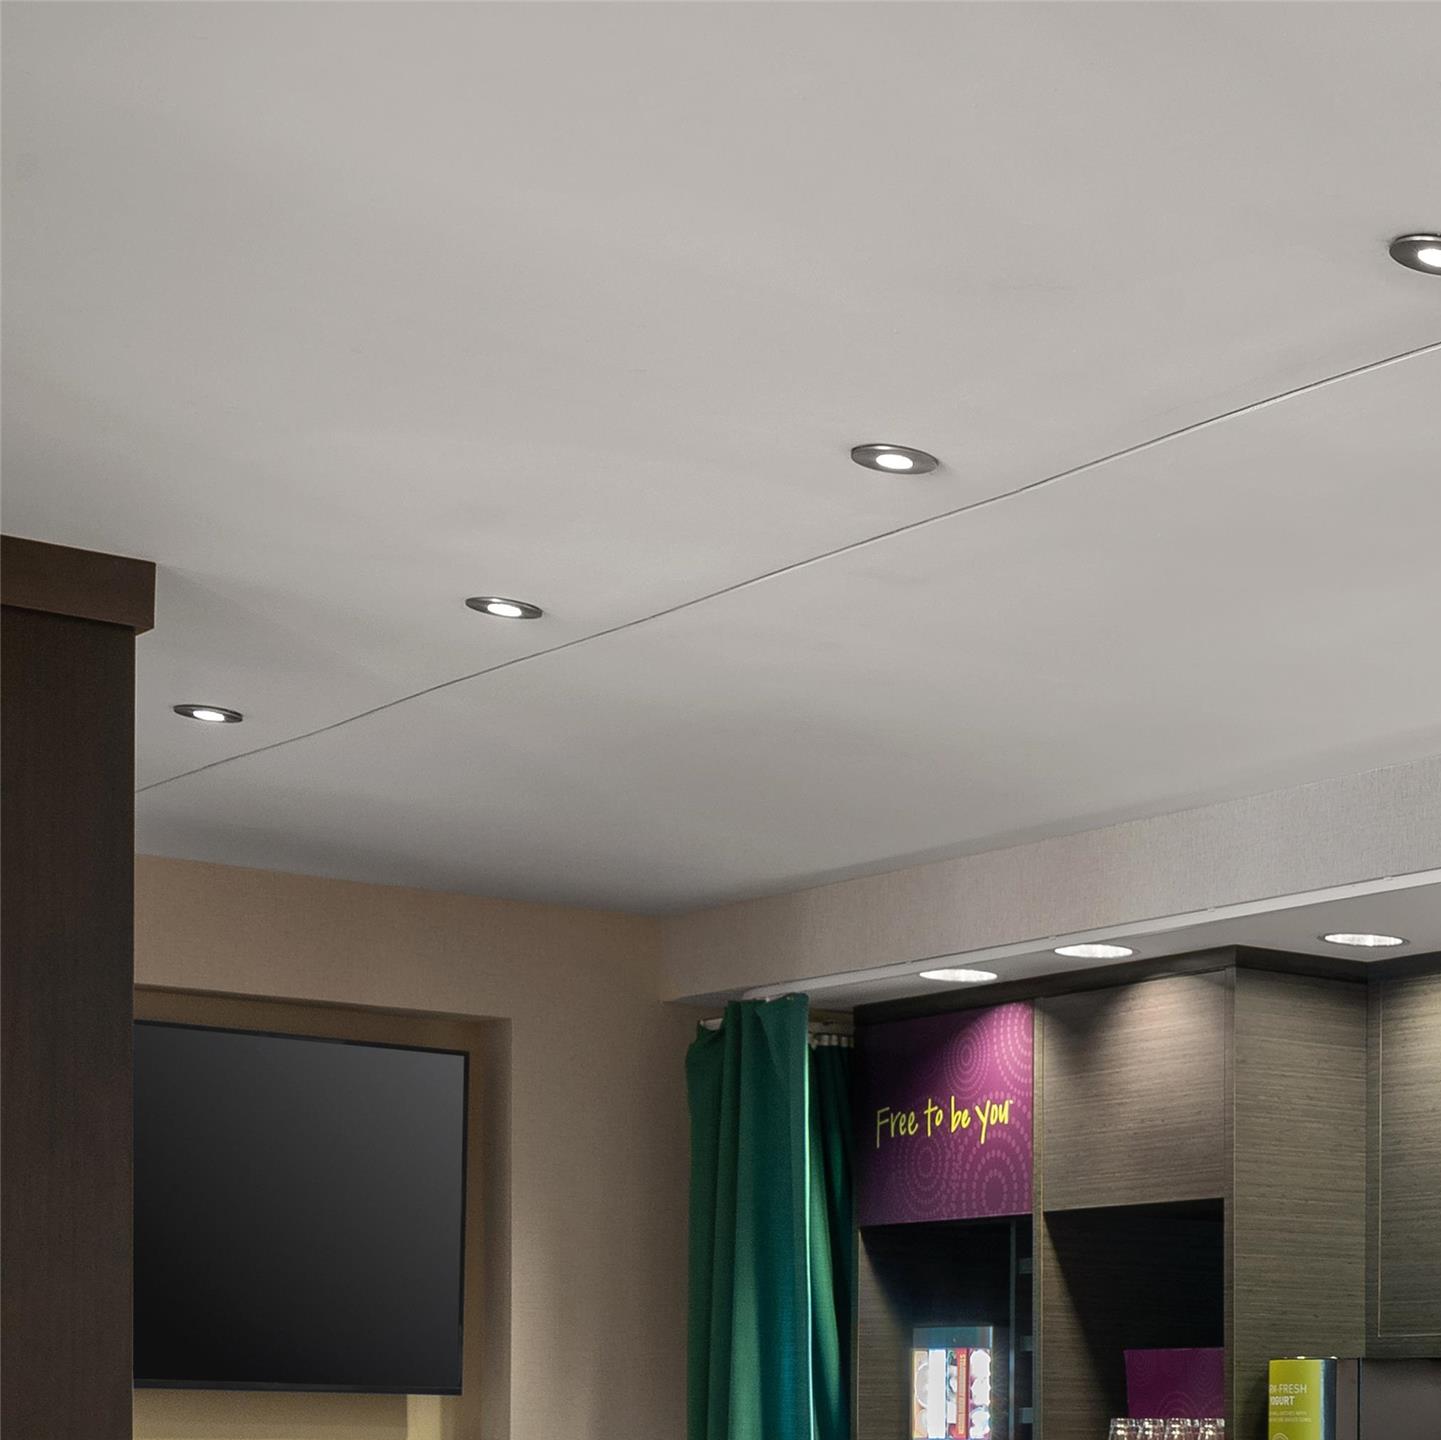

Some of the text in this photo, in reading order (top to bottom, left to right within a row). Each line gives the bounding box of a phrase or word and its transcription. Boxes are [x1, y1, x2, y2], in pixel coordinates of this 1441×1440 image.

[876, 1095, 1010, 1149] Free to be you
